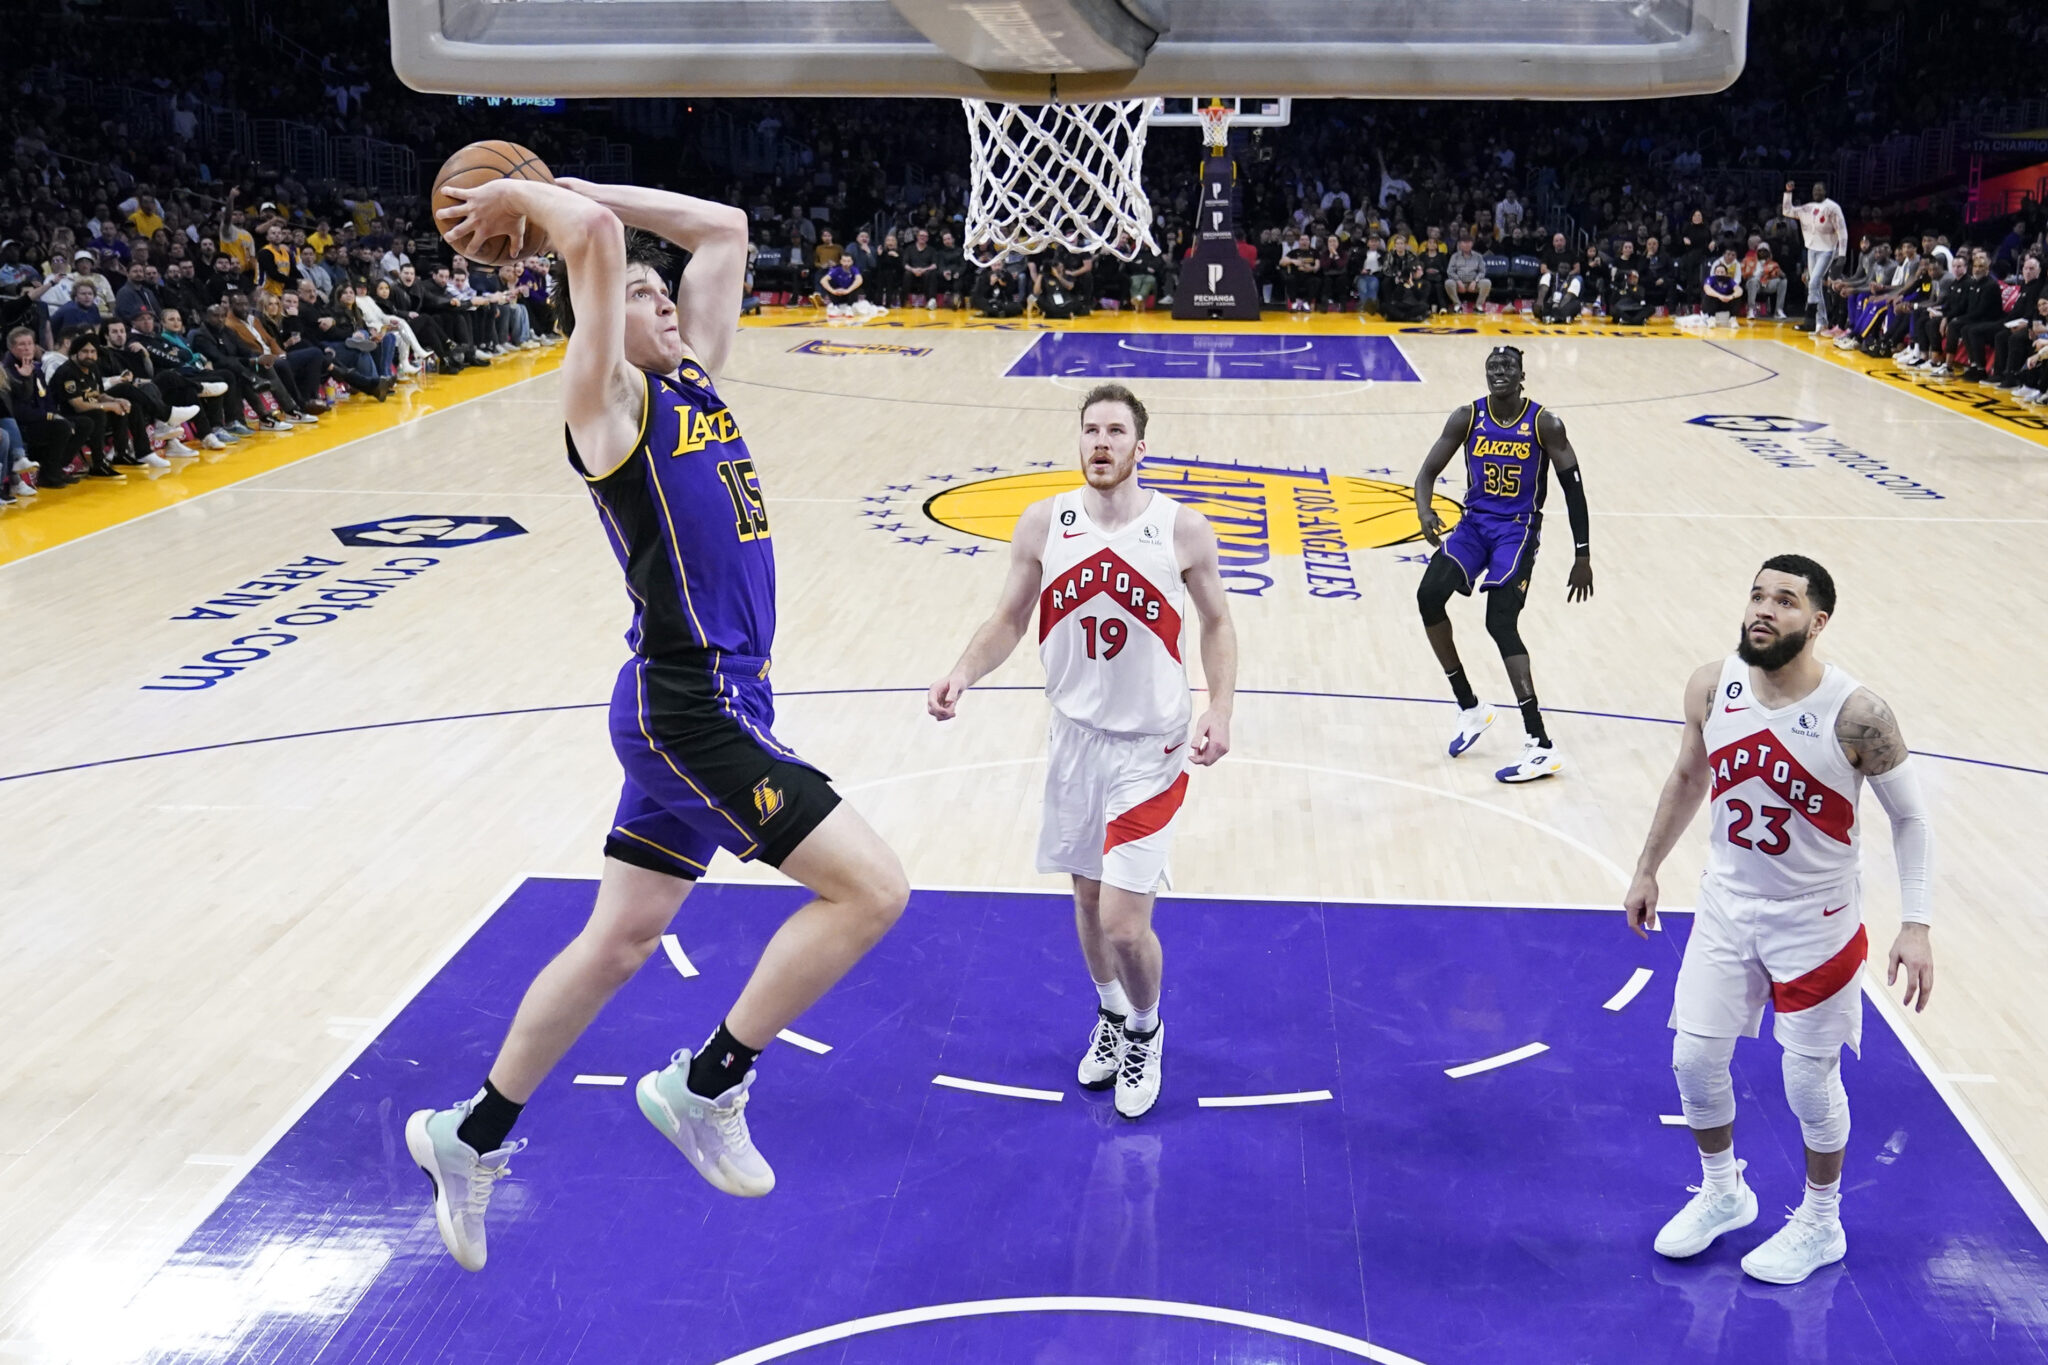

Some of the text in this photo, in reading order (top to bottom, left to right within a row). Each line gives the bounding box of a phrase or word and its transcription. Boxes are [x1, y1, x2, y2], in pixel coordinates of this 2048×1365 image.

[503, 97, 556, 107] XPRESS
[1193, 294, 1235, 302] PECHANGA
[1472, 435, 1531, 460] LAKERS
[1729, 435, 1817, 469] ARENA
[1798, 436, 1946, 500] crypto.com
[1483, 461, 1522, 498] 35
[716, 458, 772, 543] 15
[1063, 512, 1074, 526] 6
[1292, 487, 1363, 601] LOS ANGELES
[169, 554, 347, 622] ARENA
[1052, 561, 1161, 621] RAPTORS
[140, 556, 441, 692] crypto.com
[1079, 616, 1128, 661] 19
[1729, 683, 1741, 698] 6
[1791, 726, 1821, 739] Sun Life
[1725, 797, 1793, 856] 23
